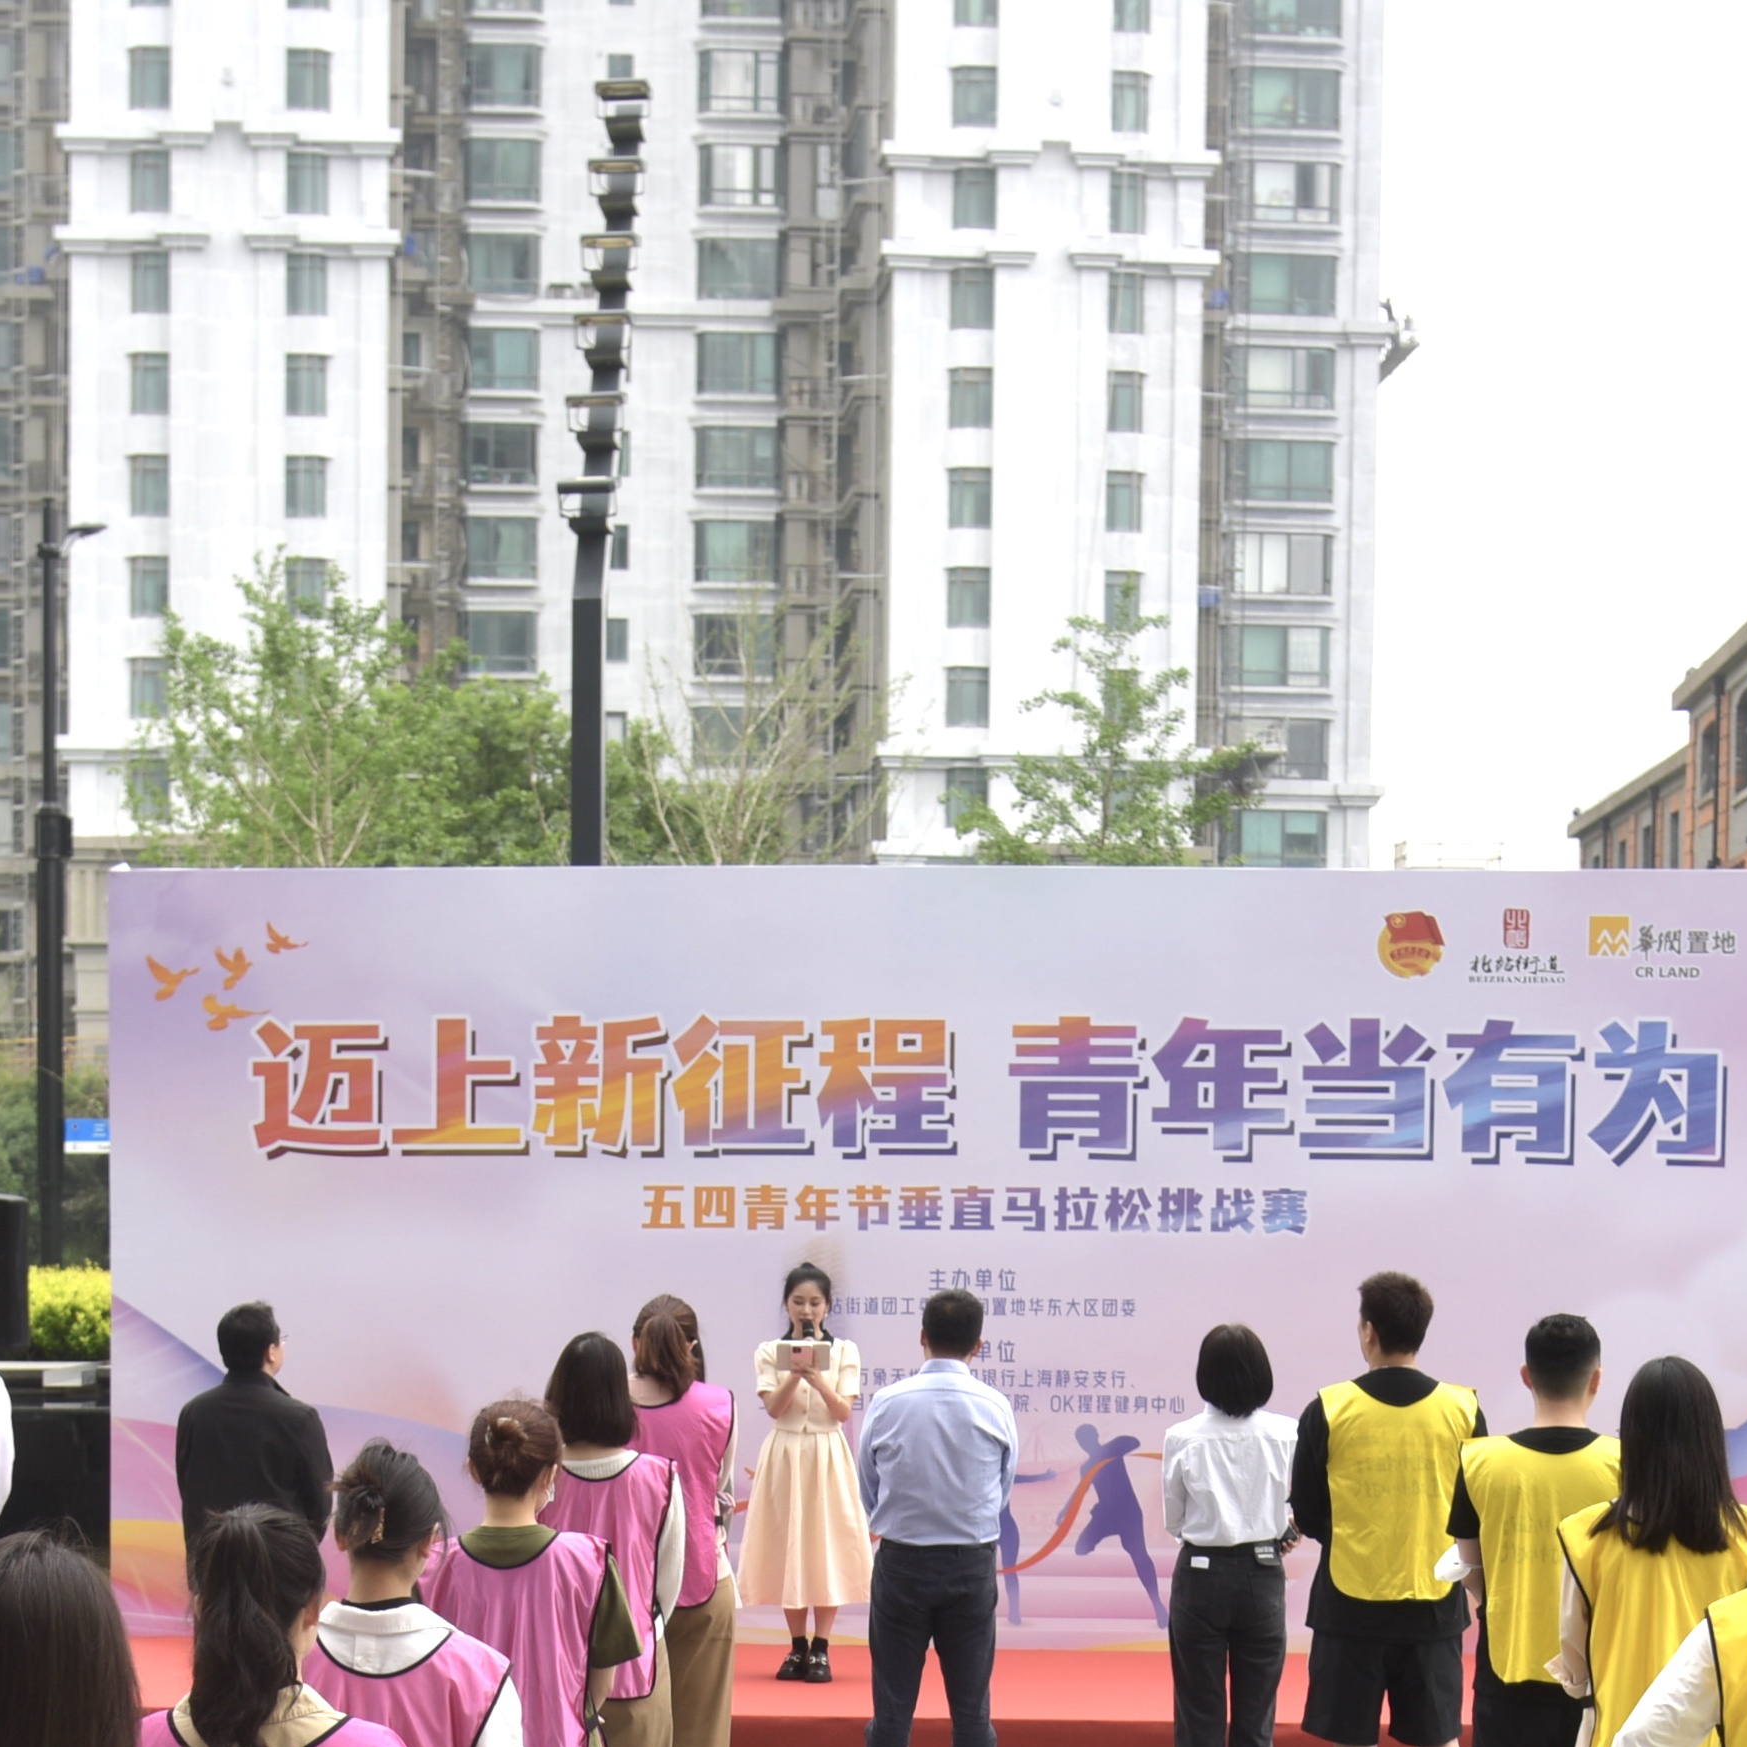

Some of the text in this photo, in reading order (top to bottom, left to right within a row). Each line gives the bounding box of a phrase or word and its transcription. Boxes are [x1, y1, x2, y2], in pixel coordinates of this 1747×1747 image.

[1635, 966, 1700, 979] CR LAND
[251, 1013, 1730, 1168] 迈上新征程 青年当有为
[640, 1183, 1310, 1235] 五四青年节垂直马拉松挑战赛
[928, 1268, 1017, 1292] 主办单位
